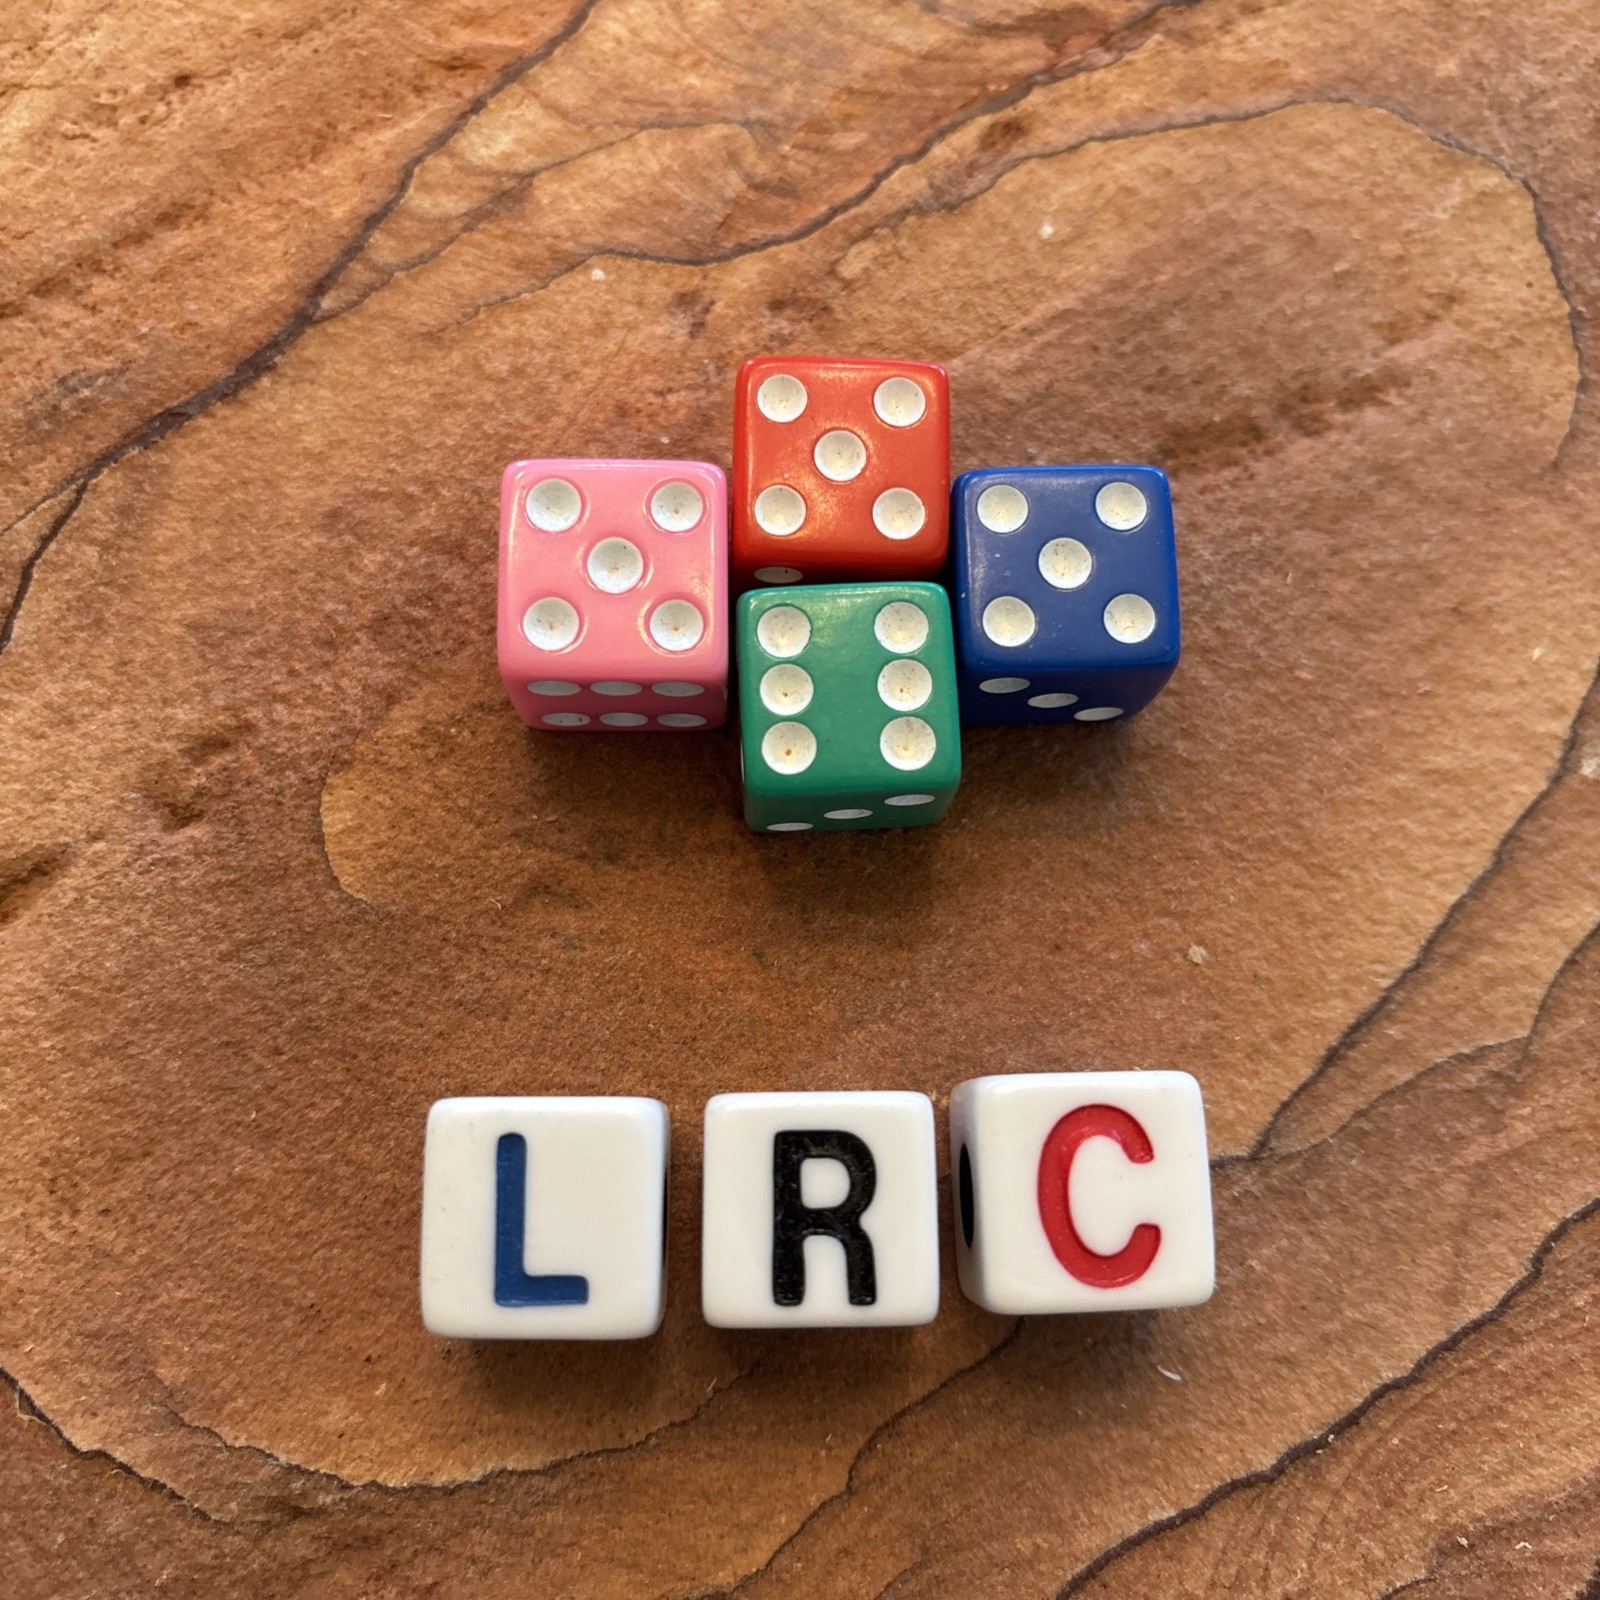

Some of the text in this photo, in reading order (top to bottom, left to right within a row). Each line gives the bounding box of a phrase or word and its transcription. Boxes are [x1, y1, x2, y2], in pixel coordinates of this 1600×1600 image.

[494, 1132, 589, 1308] L
[772, 1130, 878, 1308] R
[1036, 1102, 1162, 1290] C
